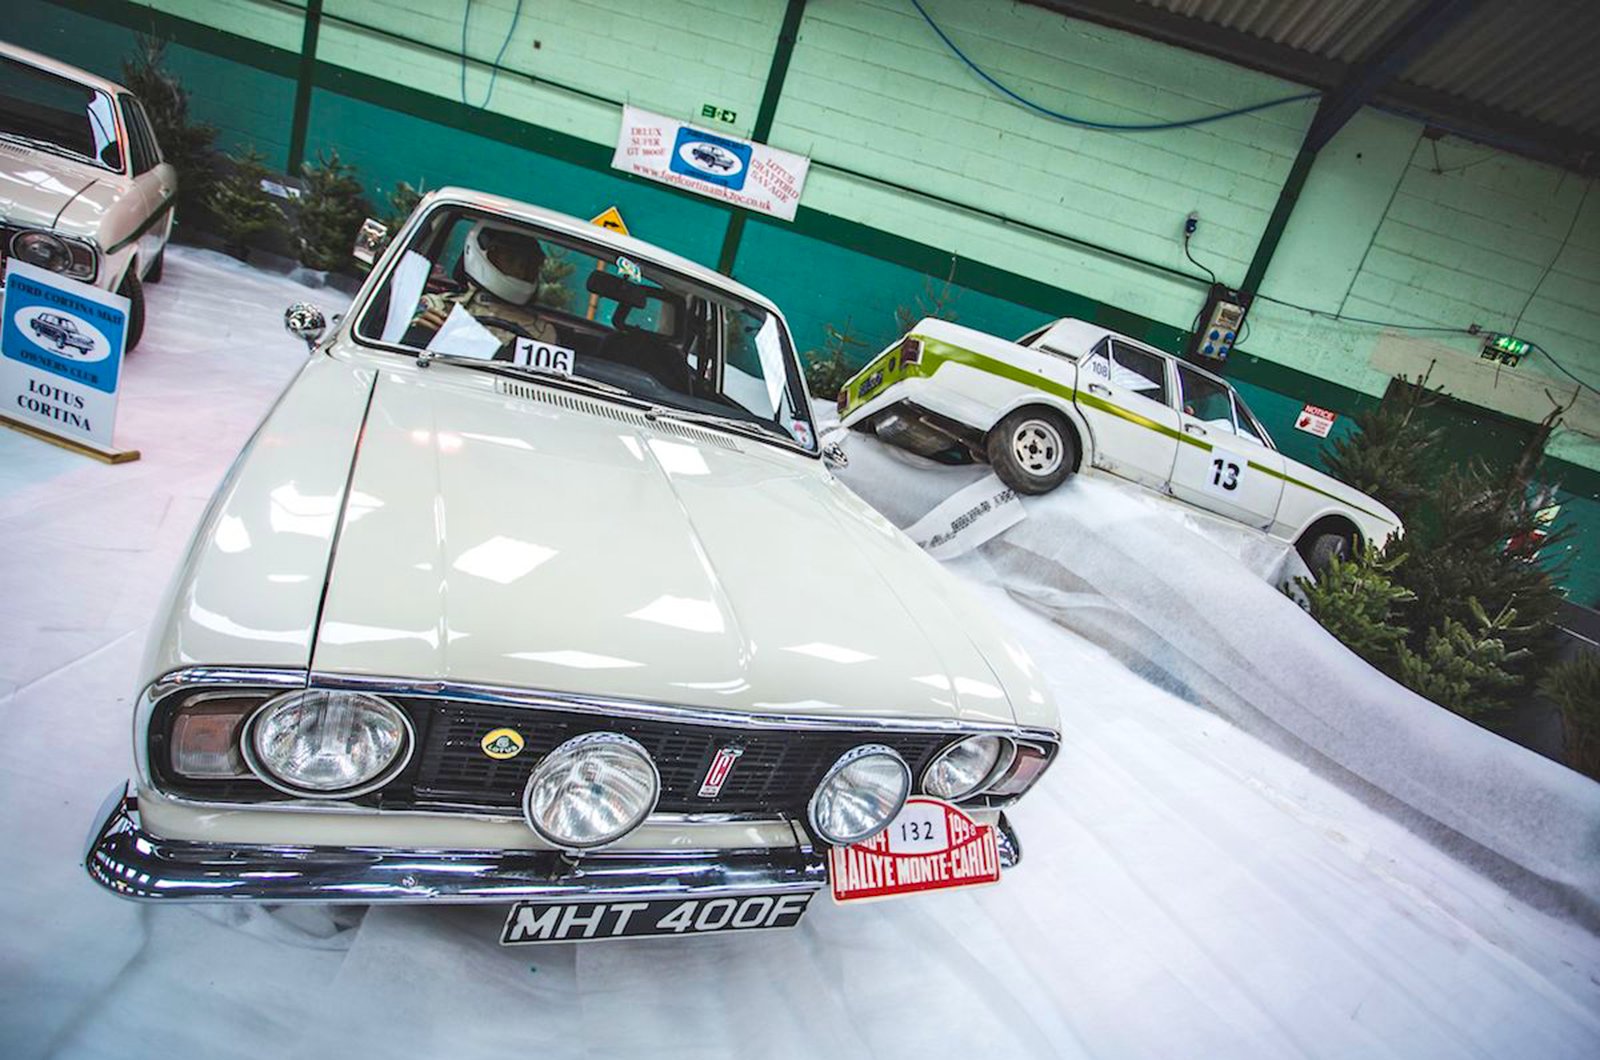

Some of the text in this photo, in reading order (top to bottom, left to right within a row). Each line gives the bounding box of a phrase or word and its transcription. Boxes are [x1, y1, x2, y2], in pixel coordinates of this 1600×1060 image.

[11, 280, 42, 298] FORD
[44, 291, 94, 317] CORTINA
[21, 350, 68, 373] OWNERS
[70, 365, 99, 384] CLUB
[522, 344, 568, 371] 106
[28, 379, 84, 409] LOTUS
[17, 394, 91, 432] CORTINA
[1304, 404, 1335, 421] NOTICE
[1213, 458, 1240, 490] 13
[901, 821, 934, 842] 132
[948, 811, 977, 846] 1998
[510, 894, 811, 940] MHT 400F
